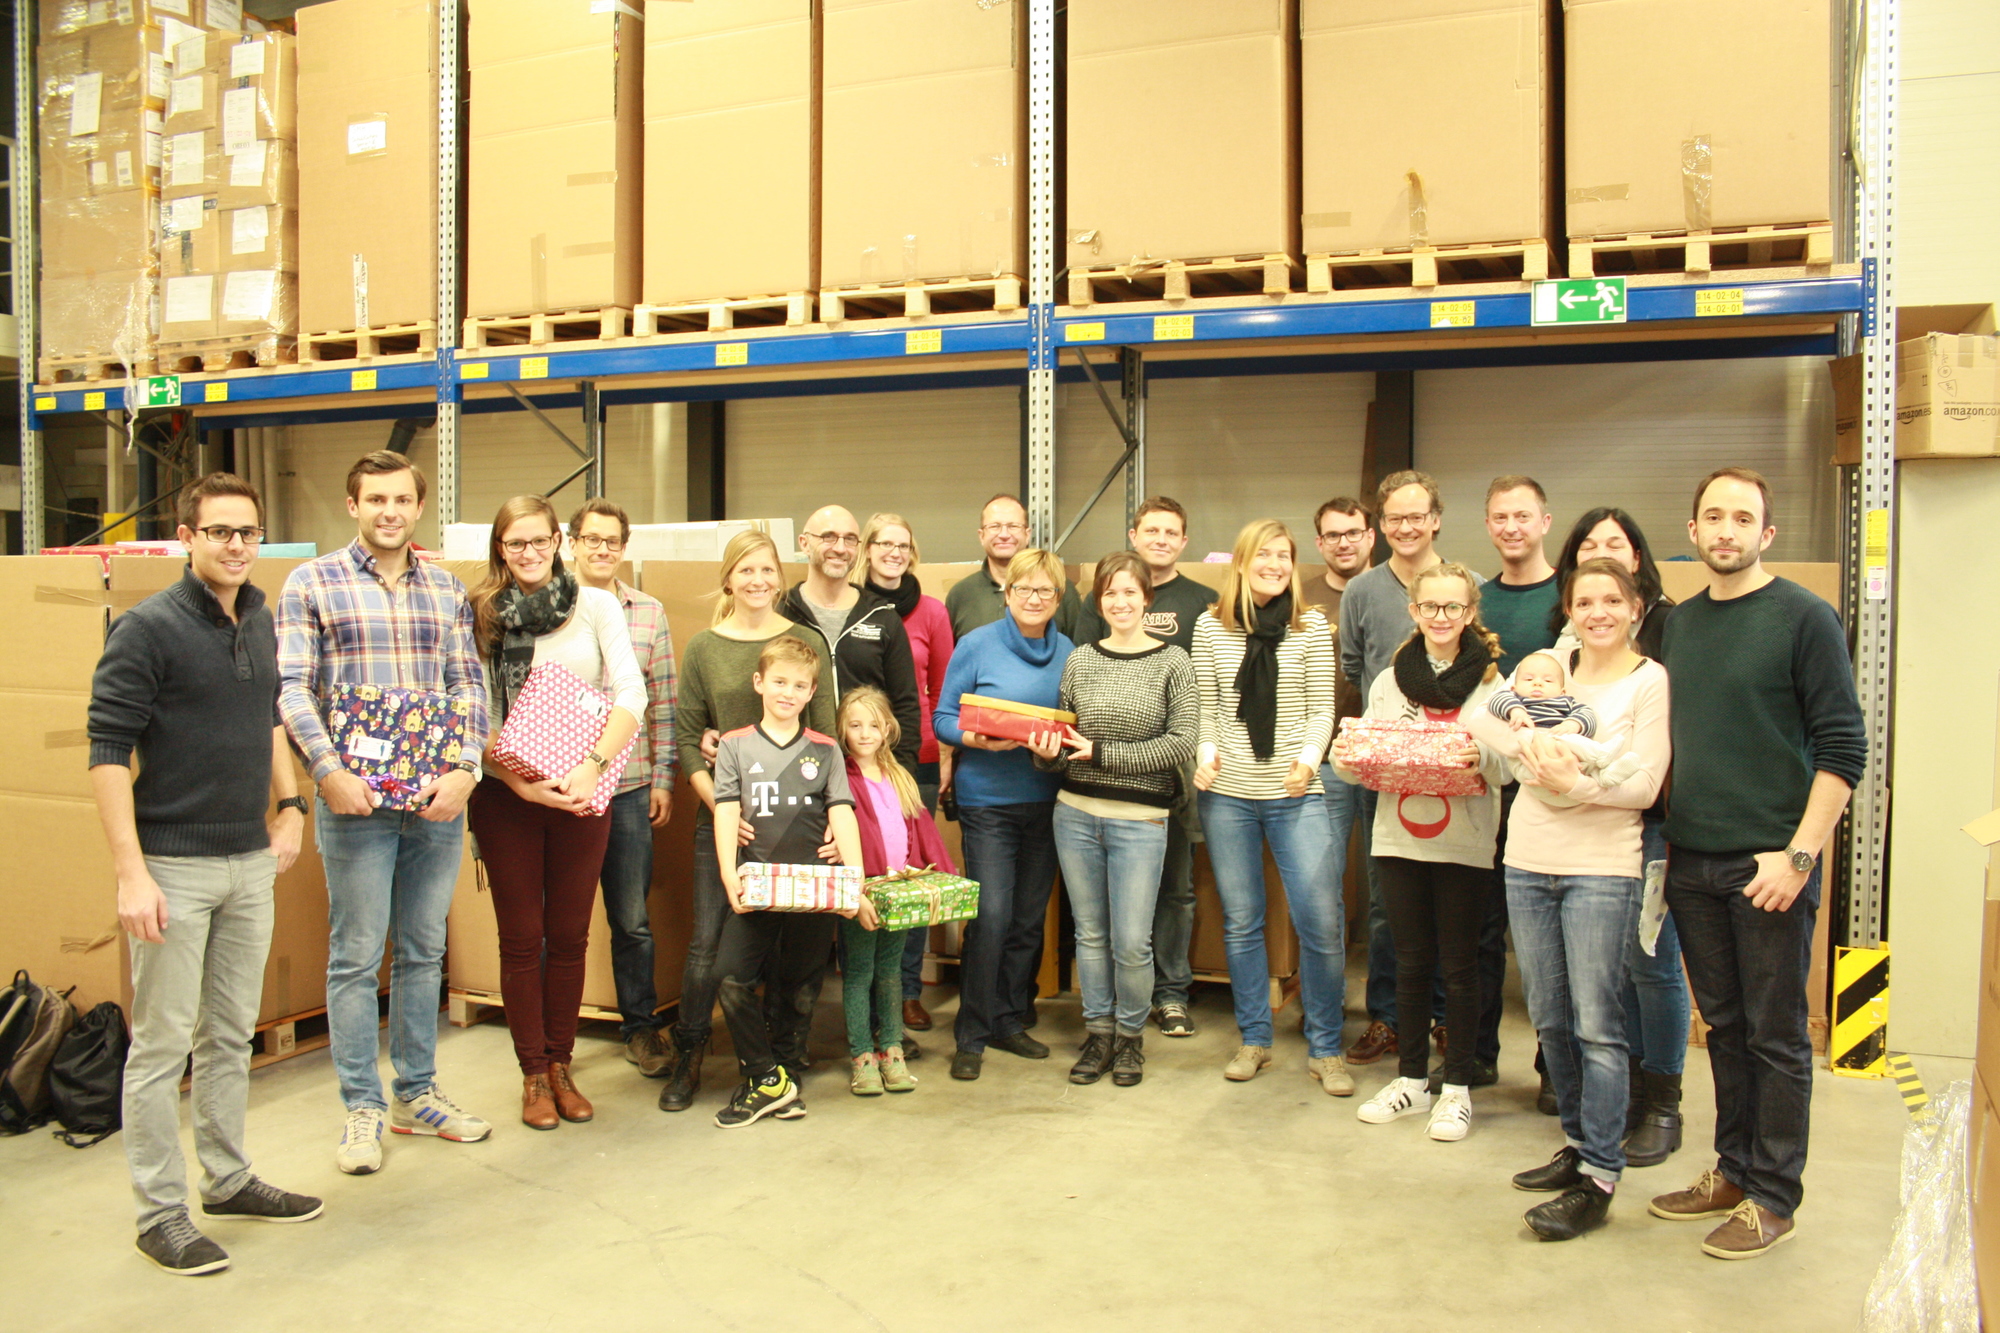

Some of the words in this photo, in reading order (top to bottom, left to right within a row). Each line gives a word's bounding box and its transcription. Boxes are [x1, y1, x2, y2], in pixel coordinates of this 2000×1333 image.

[1703, 291, 1740, 301] 14-02-04
[1703, 304, 1740, 313] 14-02-01
[1142, 612, 1177, 626] ATIX
